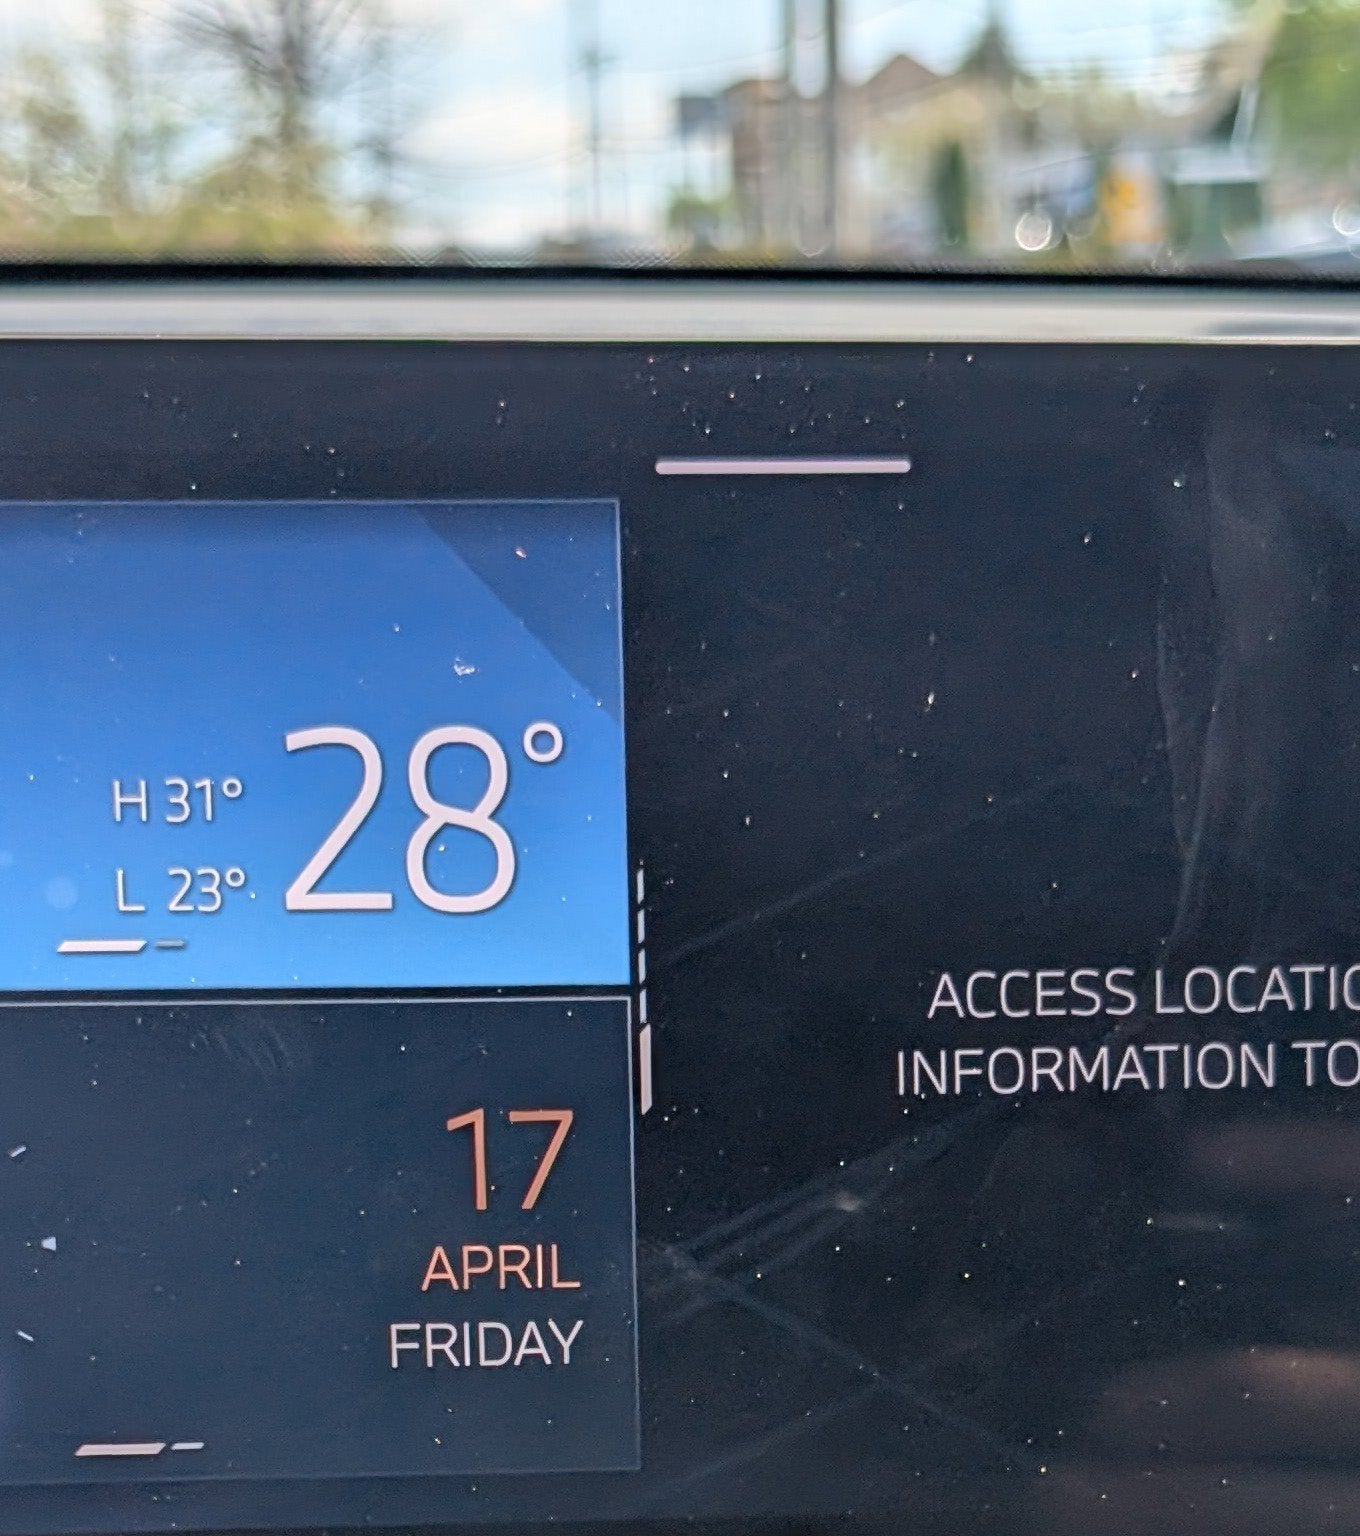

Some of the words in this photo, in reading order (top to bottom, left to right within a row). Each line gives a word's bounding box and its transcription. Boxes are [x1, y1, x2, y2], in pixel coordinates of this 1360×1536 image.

[113, 780, 148, 822] H
[115, 868, 146, 912] L
[927, 966, 1138, 1020] ACCESS
[896, 1040, 1275, 1096] INFORMATION
[446, 1107, 574, 1211] 17
[421, 1243, 582, 1291] APRIL
[389, 1319, 584, 1368] FRIDAY
